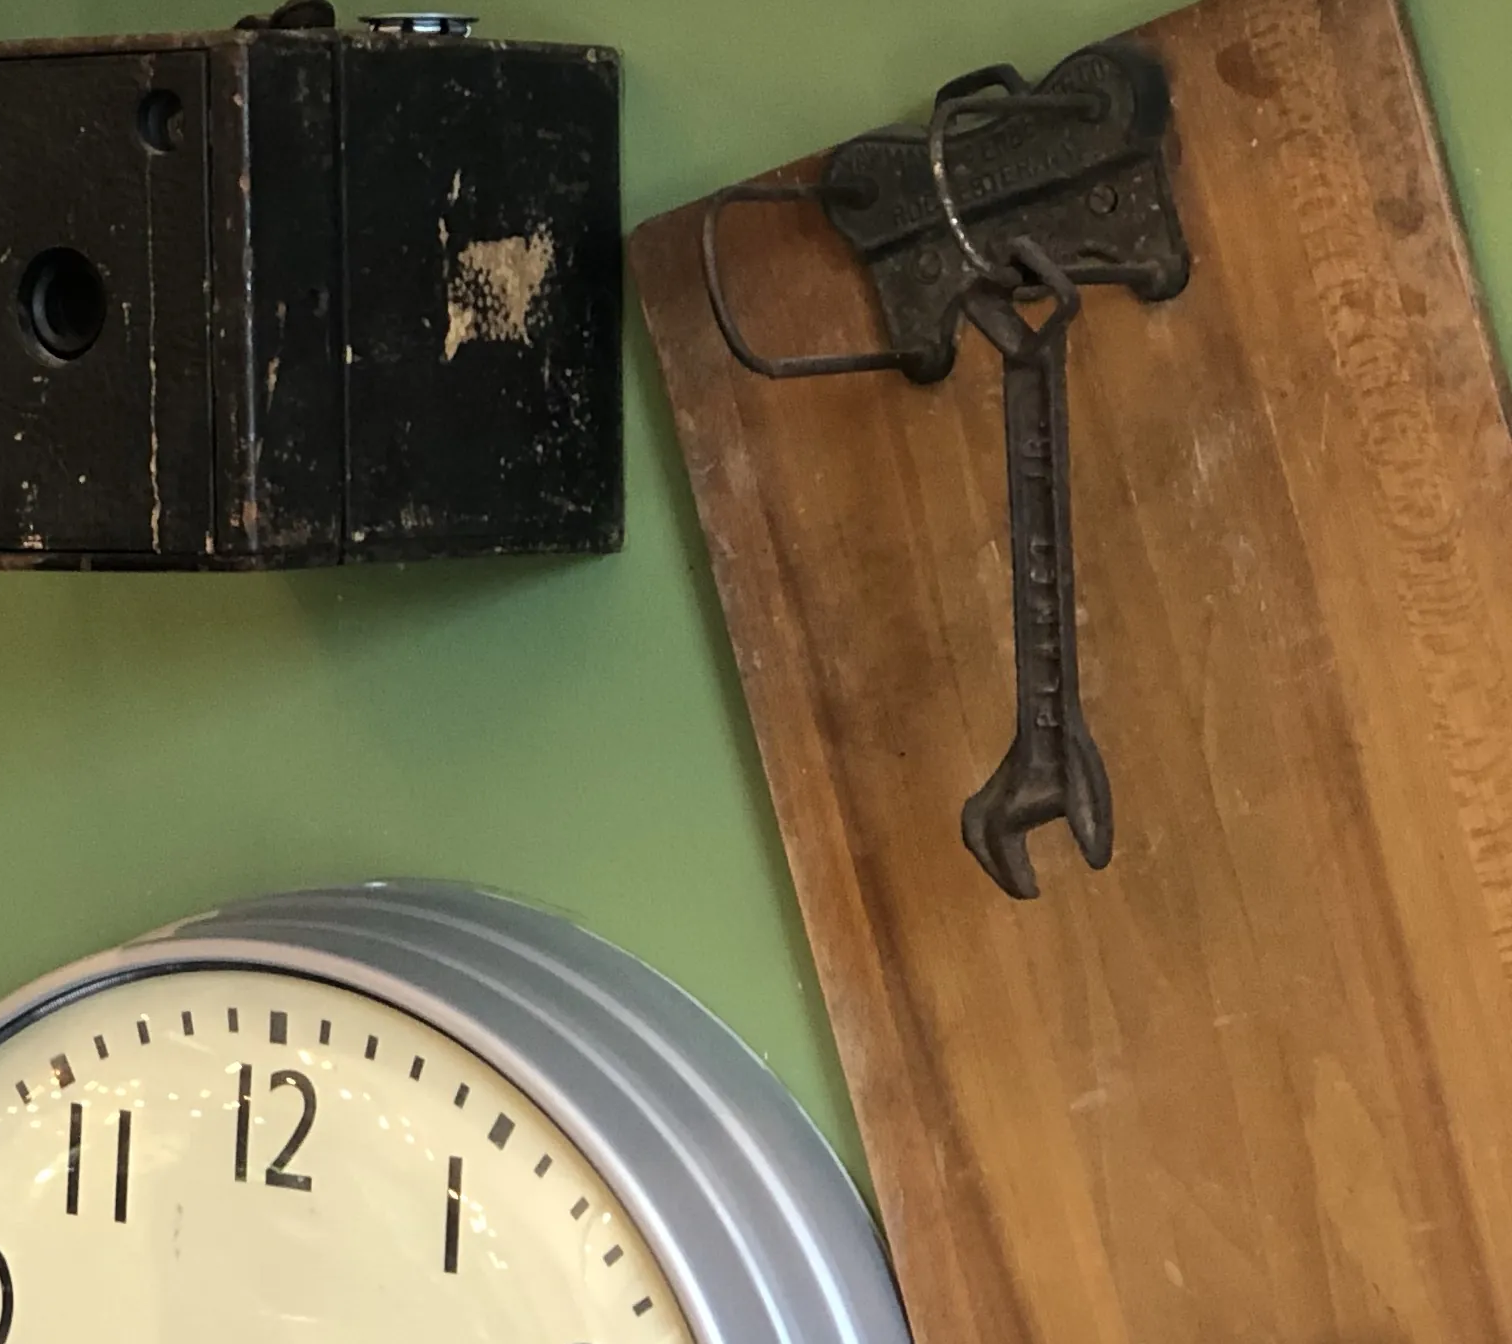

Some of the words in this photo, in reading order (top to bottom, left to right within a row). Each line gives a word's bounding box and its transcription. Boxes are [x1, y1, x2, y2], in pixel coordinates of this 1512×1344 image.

[66, 1102, 131, 1223] 11
[234, 1063, 320, 1192] 12
[443, 1156, 463, 1274] 1
